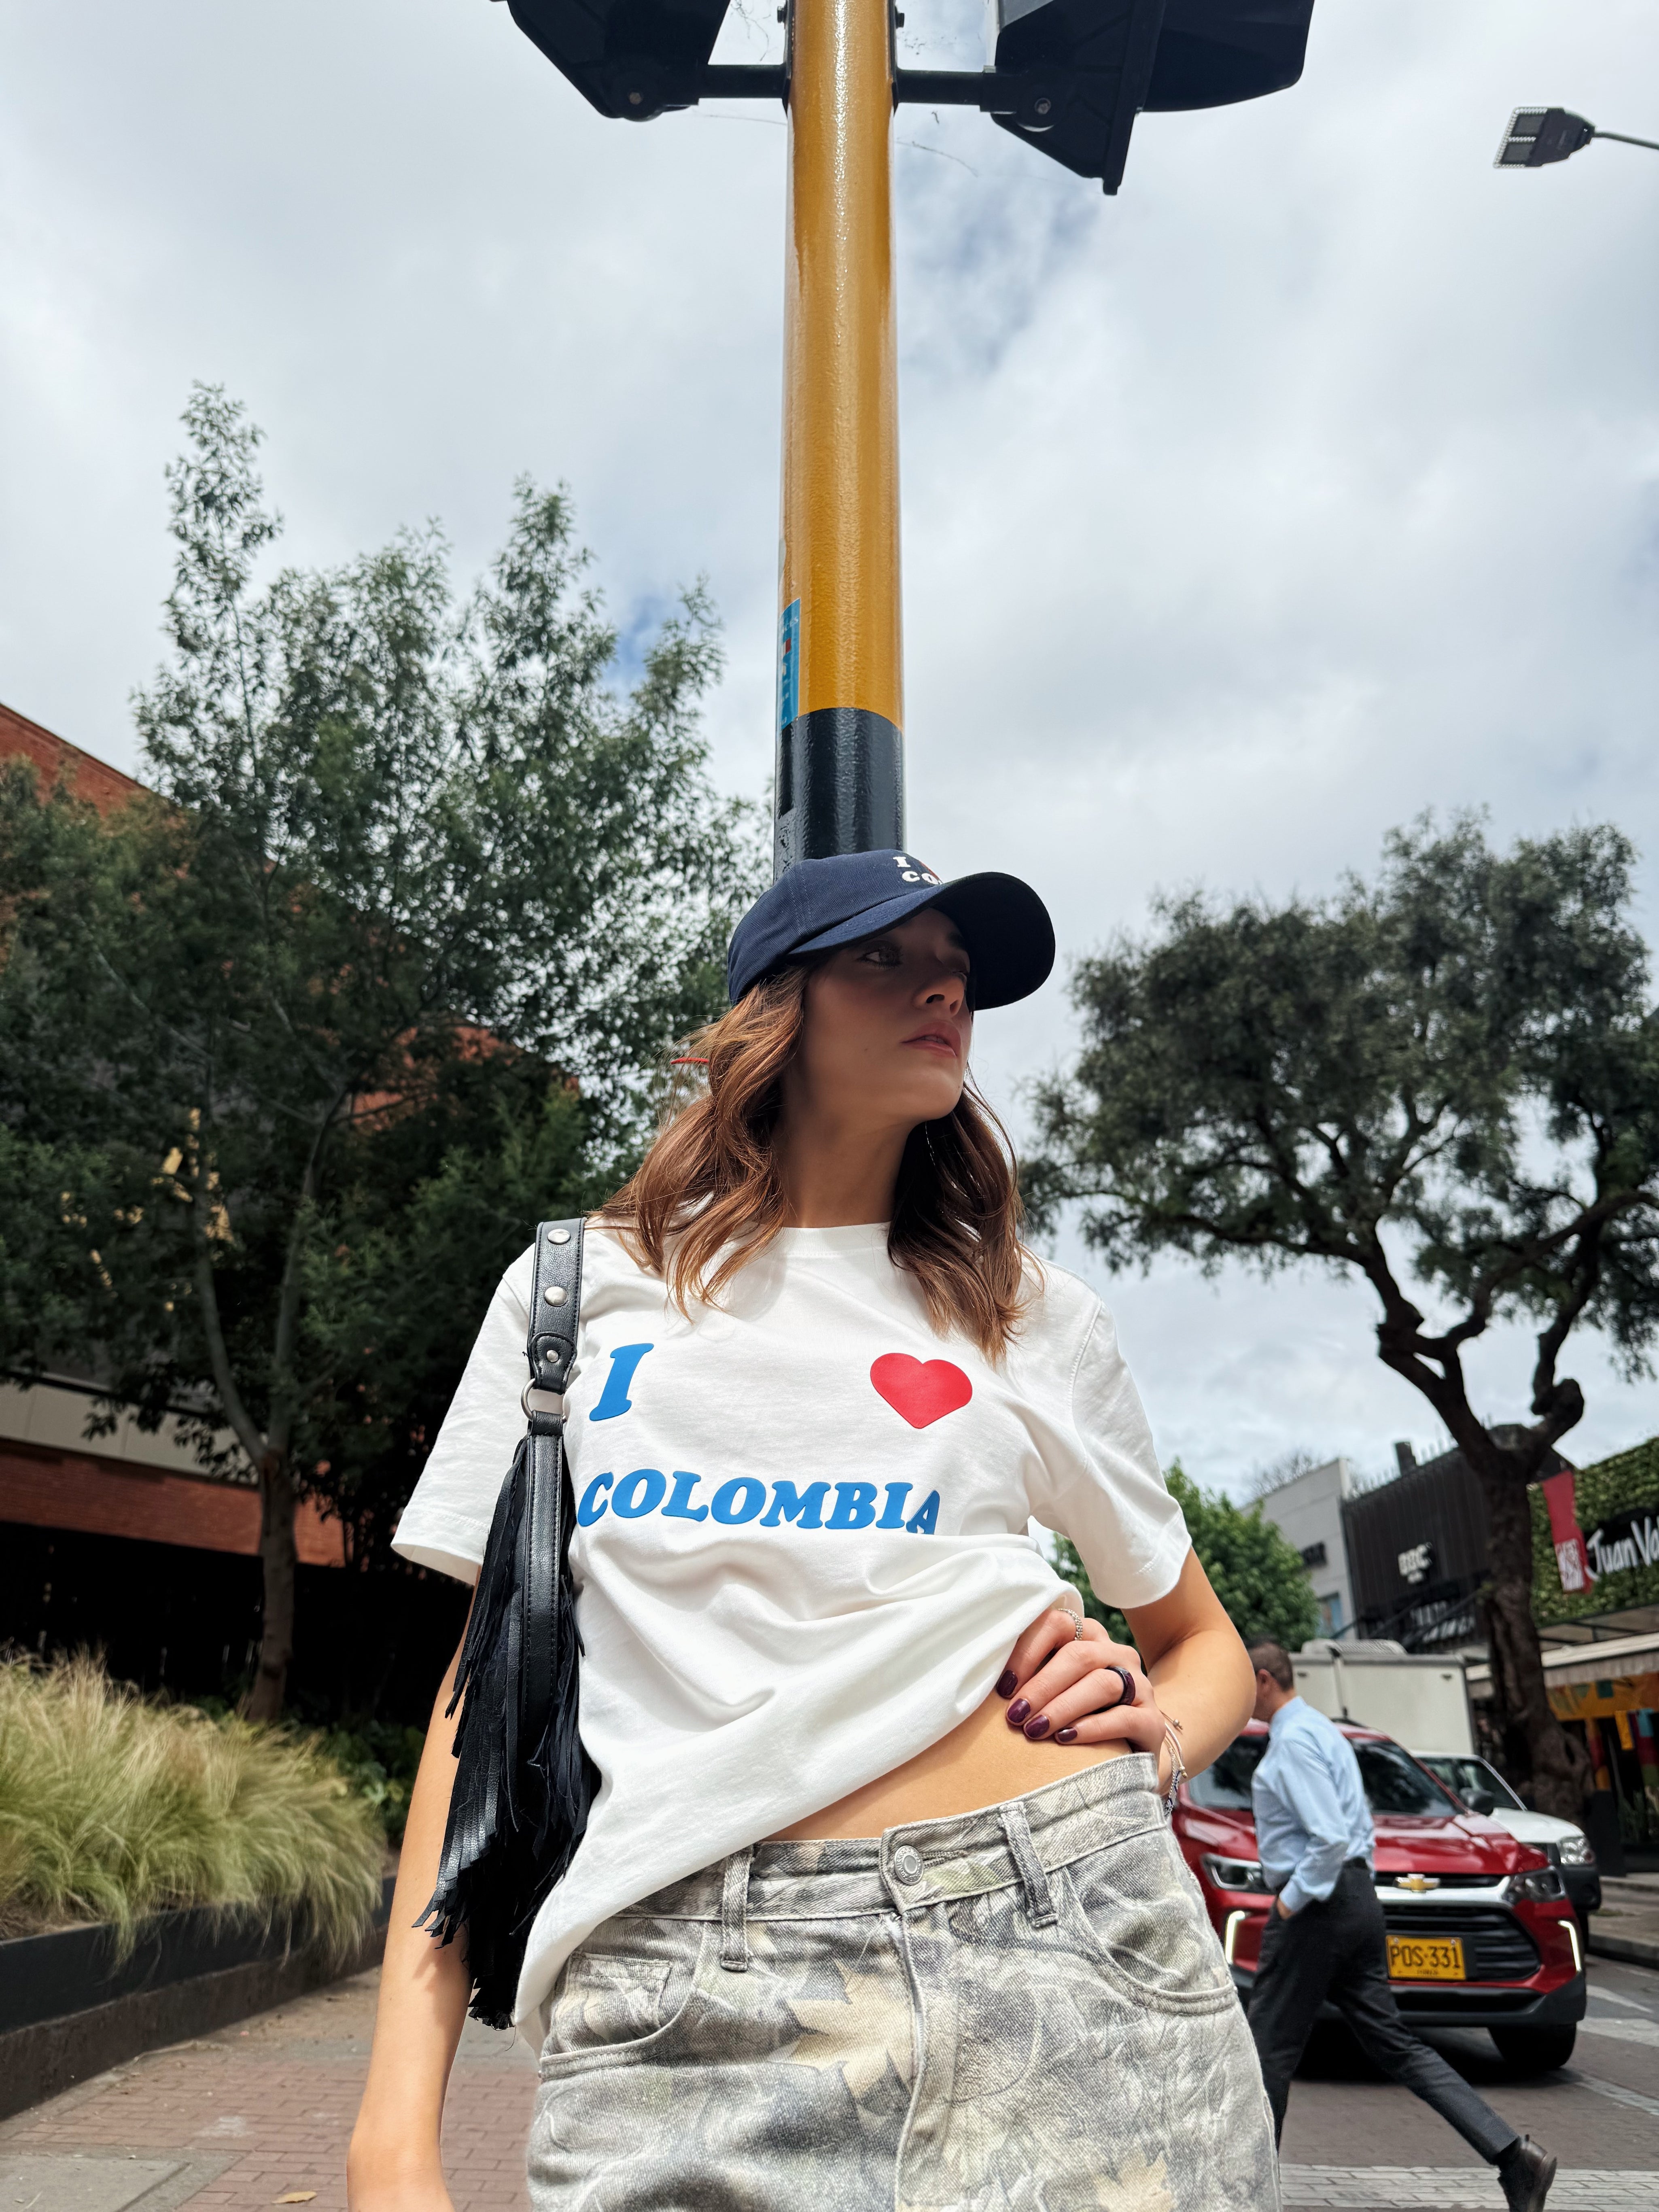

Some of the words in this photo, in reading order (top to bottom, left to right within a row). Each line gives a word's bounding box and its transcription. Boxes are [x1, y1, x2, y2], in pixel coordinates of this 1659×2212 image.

[893, 856, 910, 867] I
[589, 1343, 654, 1421] I
[577, 1469, 940, 1535] COLOMBIA
[1585, 1528, 1638, 1582] Juan
[1630, 1516, 1659, 1567] Va
